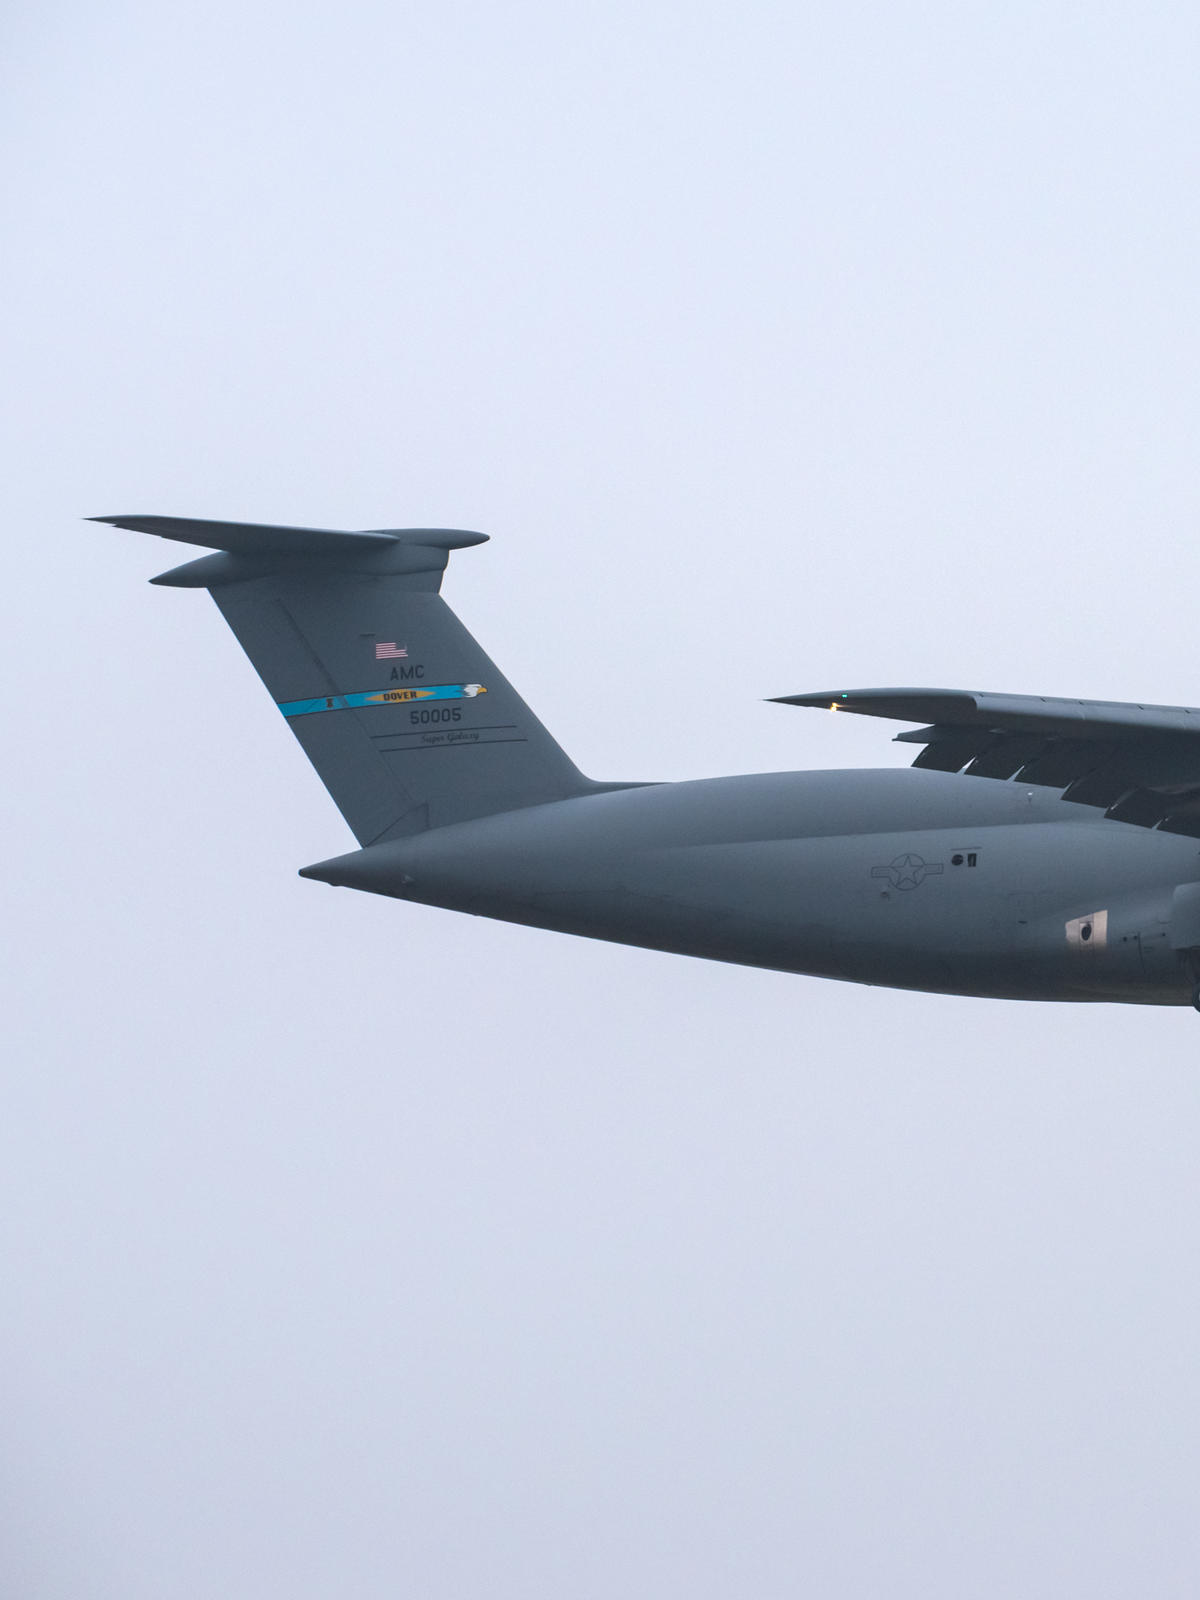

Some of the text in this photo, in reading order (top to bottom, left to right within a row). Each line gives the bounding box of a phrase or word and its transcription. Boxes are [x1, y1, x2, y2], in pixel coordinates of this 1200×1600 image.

[390, 664, 425, 681] AMC
[383, 691, 417, 701] DOVER
[410, 707, 462, 725] 50005
